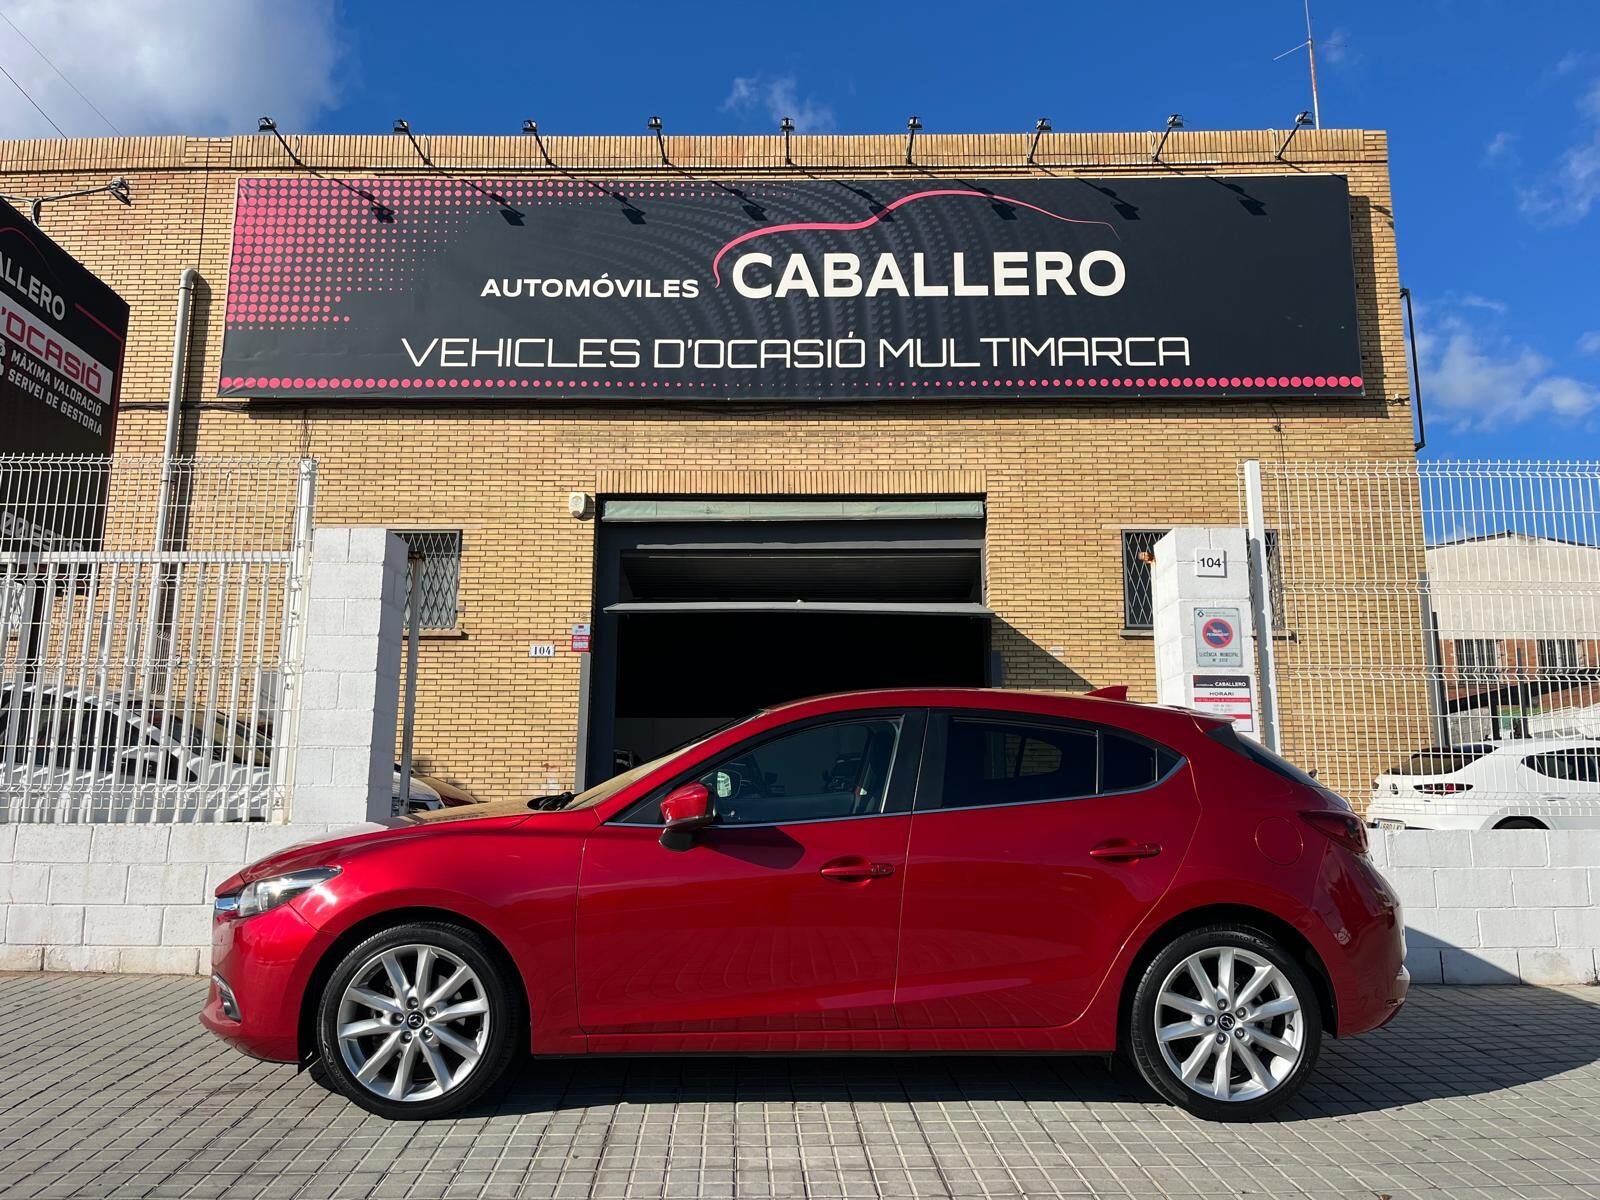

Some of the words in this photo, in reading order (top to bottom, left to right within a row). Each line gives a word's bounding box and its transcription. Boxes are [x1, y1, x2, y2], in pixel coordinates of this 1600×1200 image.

[480, 272, 700, 298] AUTOMÓVILES
[732, 250, 1127, 299] CABALLERO
[400, 337, 641, 369] VEHICLES
[653, 330, 866, 370] D'OCASIÓ
[879, 336, 1191, 368] MULTIMARCA
[8, 368, 45, 400] SERVEI
[45, 391, 59, 409] DE
[60, 401, 102, 437] GESTORIA
[11, 349, 51, 386] MÀXIMA
[53, 376, 102, 417] VALORACIÓ
[1199, 557, 1222, 568] 104
[534, 646, 551, 655] 104
